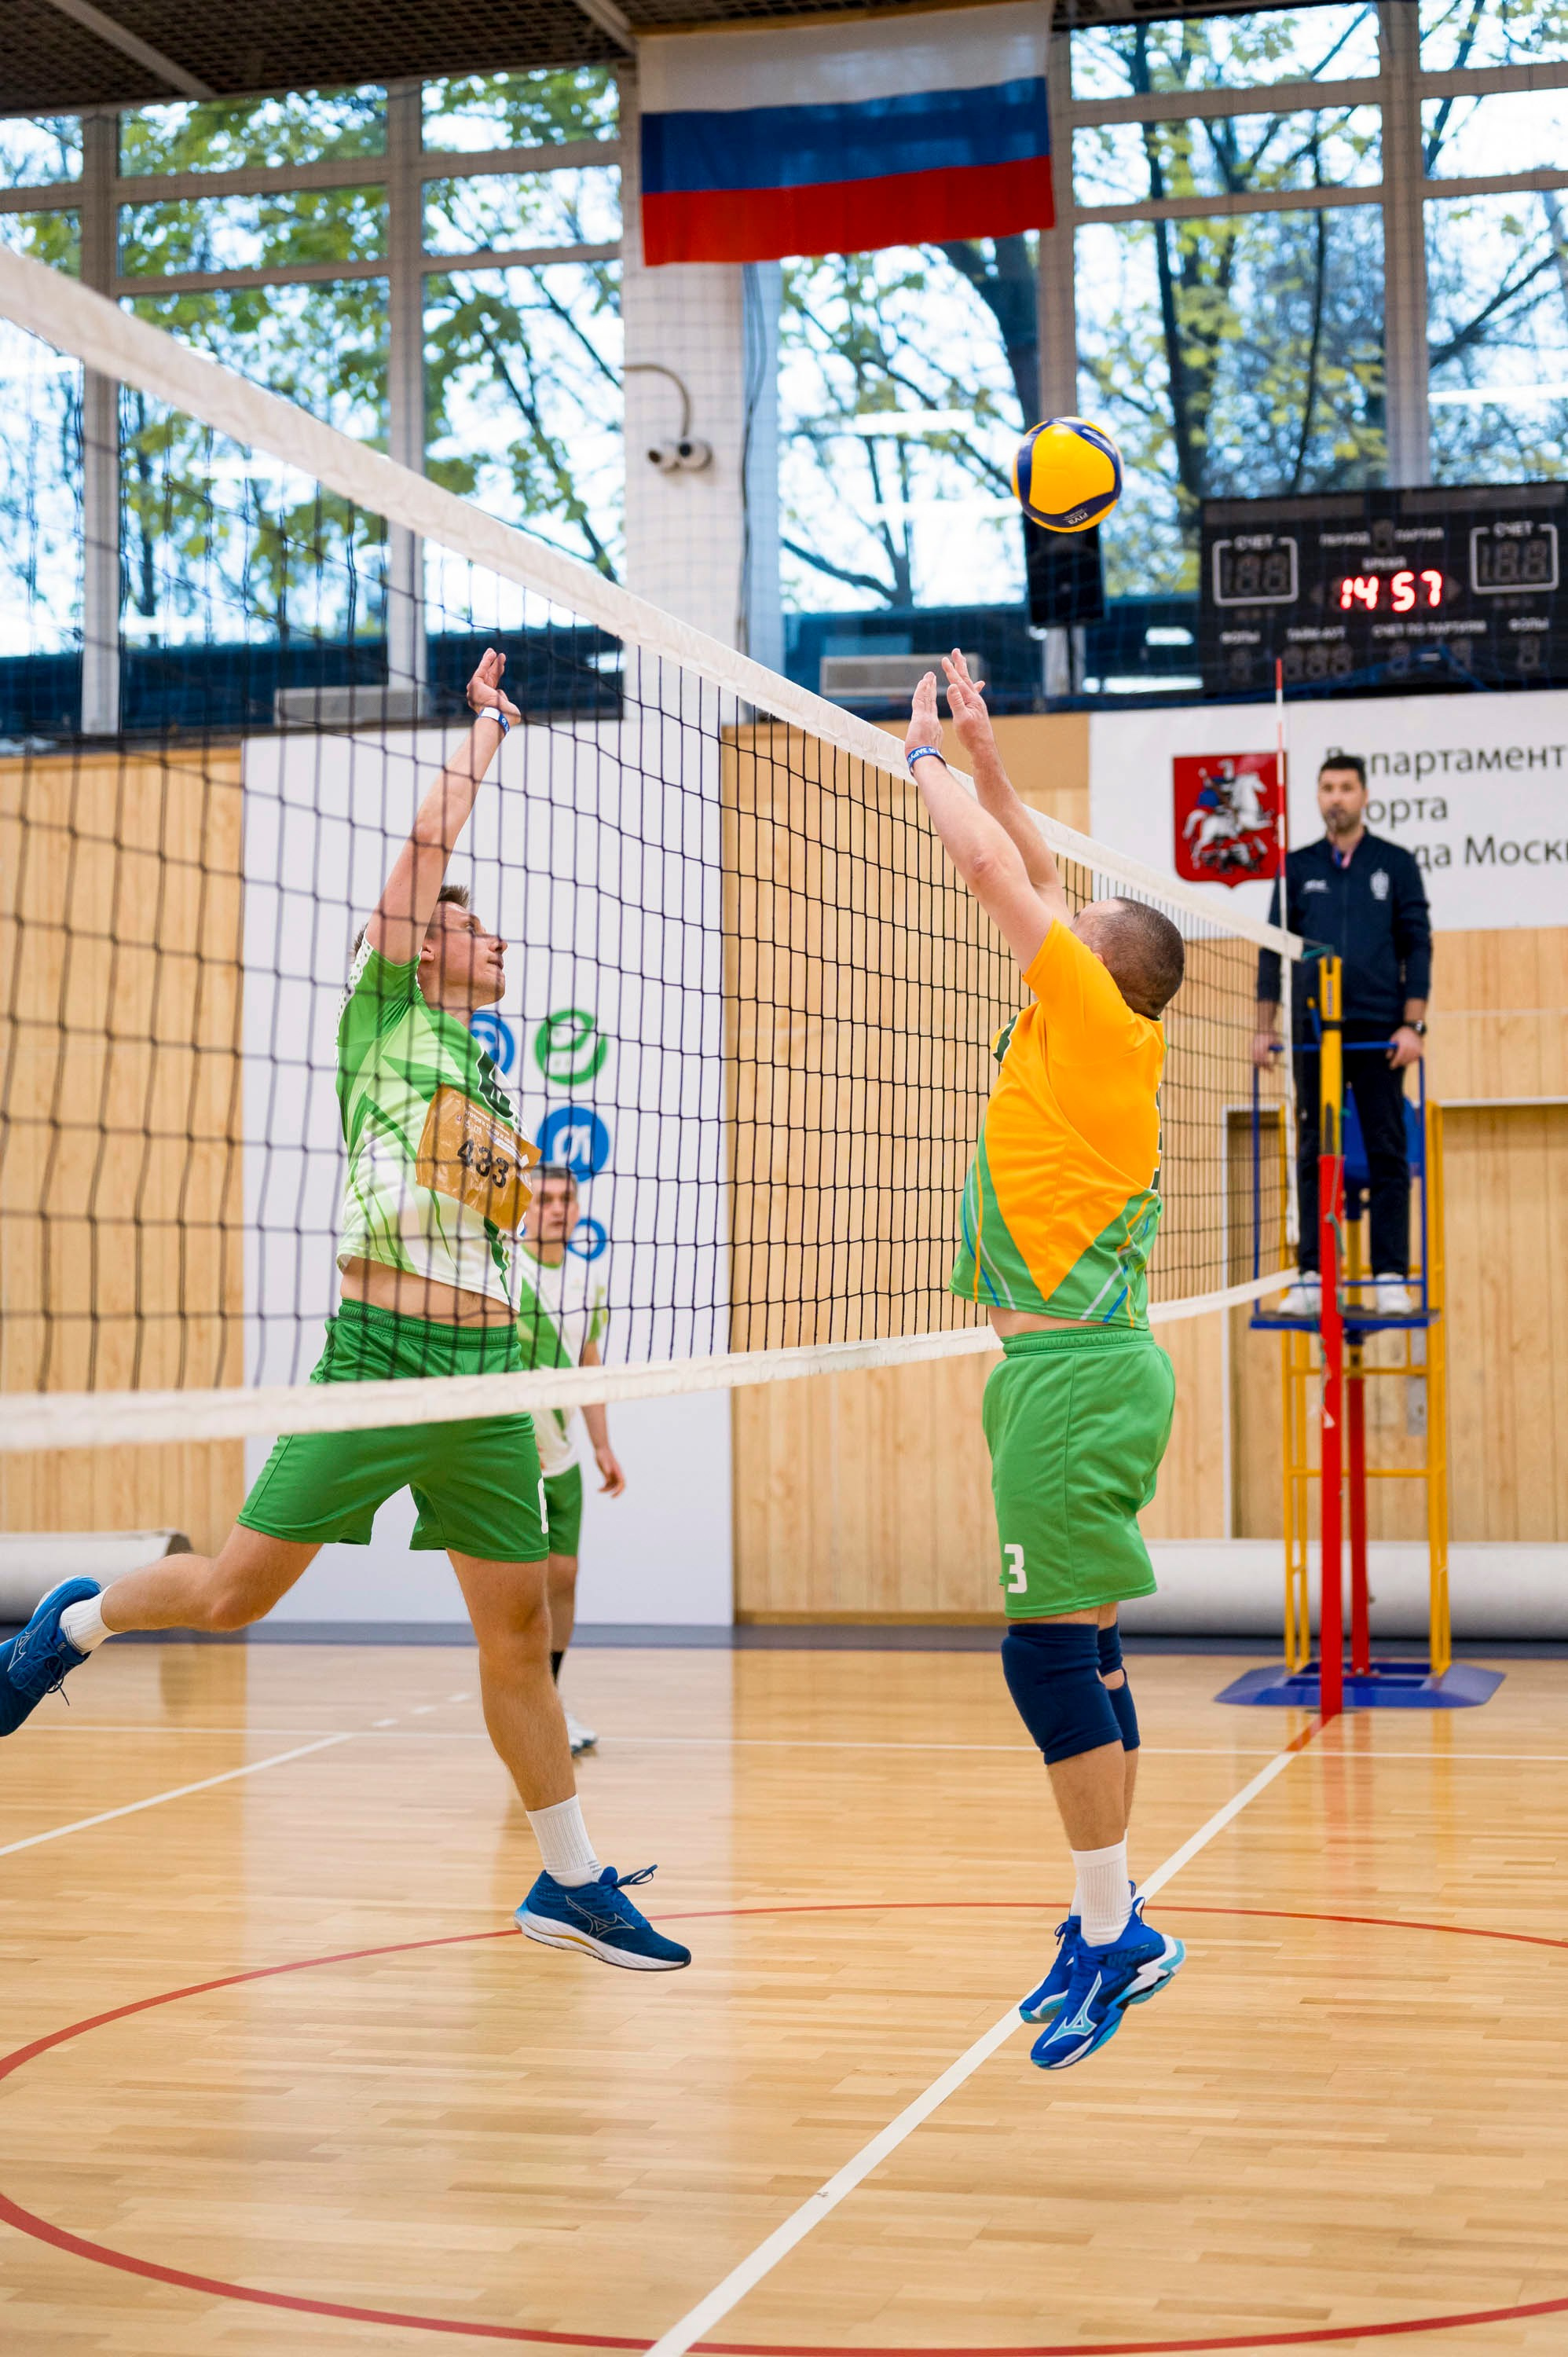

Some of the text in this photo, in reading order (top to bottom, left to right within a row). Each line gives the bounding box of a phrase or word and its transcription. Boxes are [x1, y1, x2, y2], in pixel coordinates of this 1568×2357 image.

[1234, 533, 1273, 551] СЧЕТ
[1493, 520, 1533, 537] СЧЕТ
[1326, 745, 1566, 781] партамент
[1365, 797, 1448, 828] орта
[1465, 834, 1568, 867] Моск
[456, 1139, 509, 1188] 433
[1004, 1543, 1028, 1594] 3
